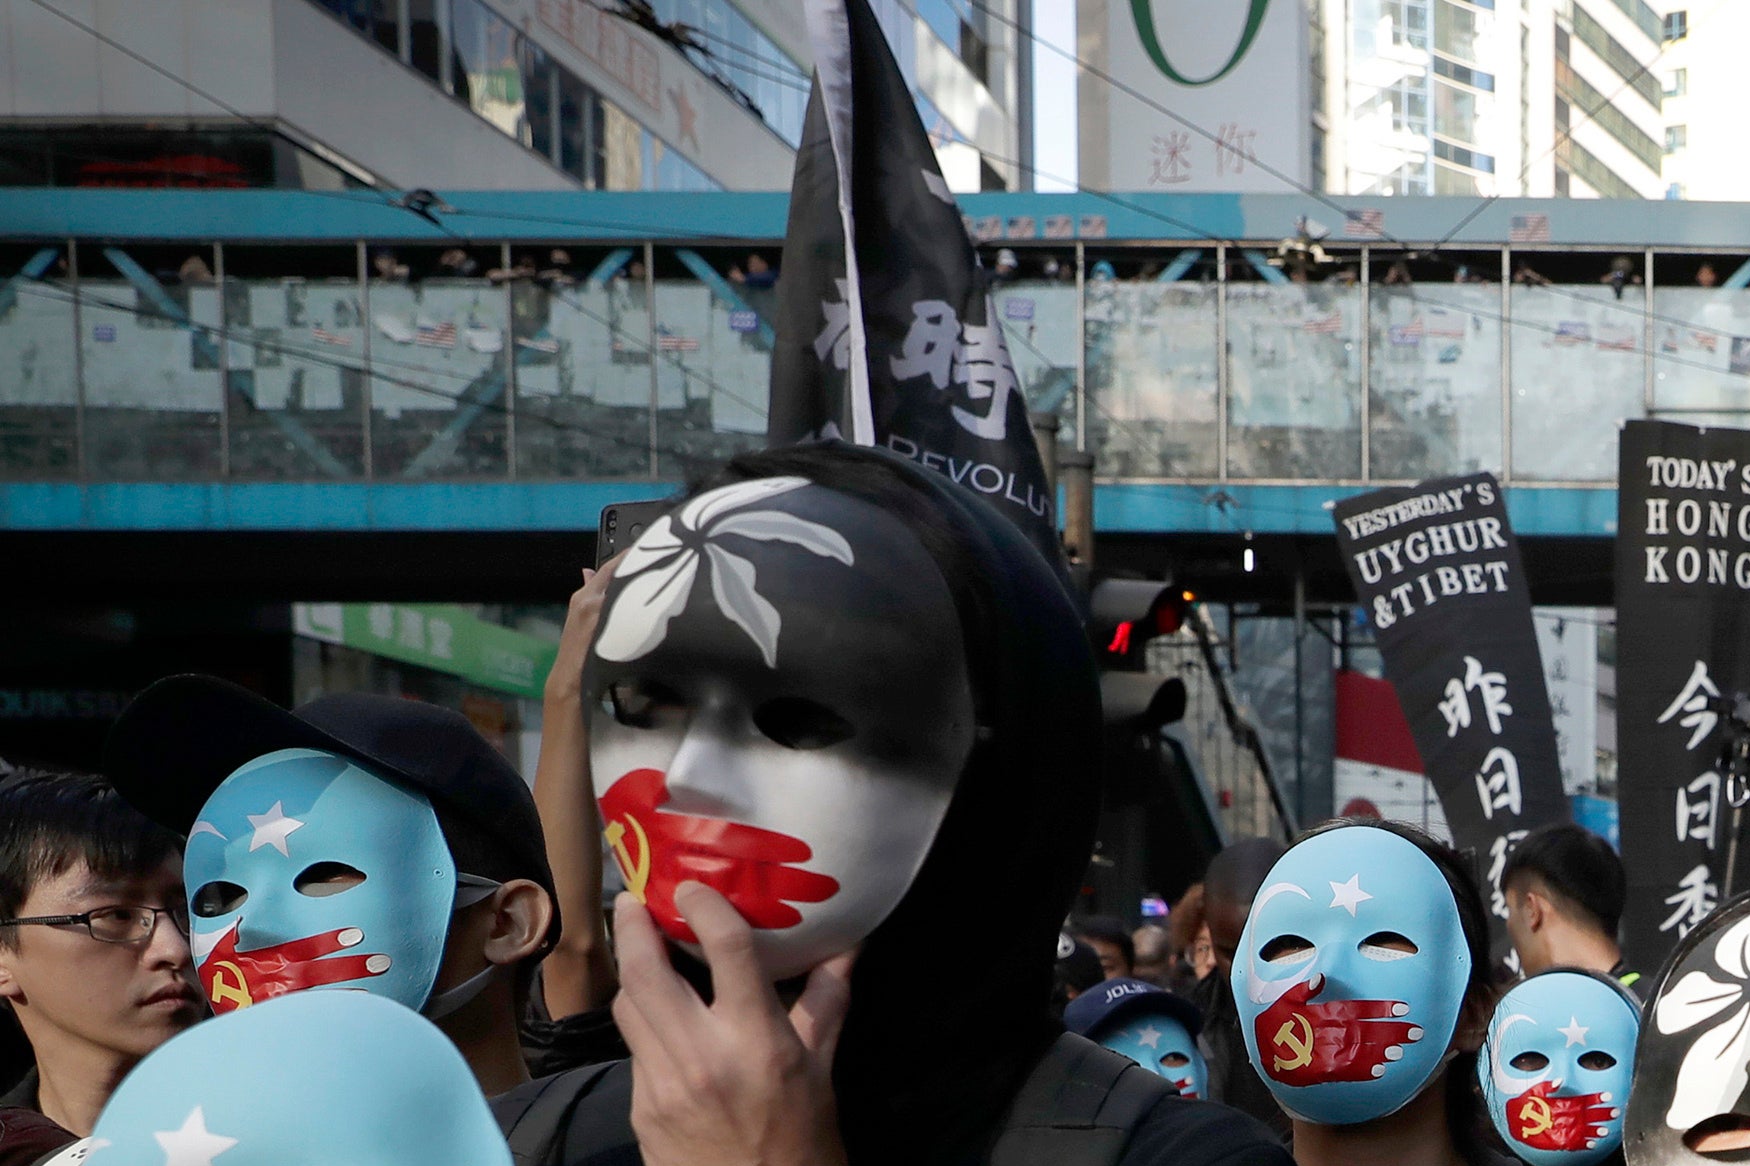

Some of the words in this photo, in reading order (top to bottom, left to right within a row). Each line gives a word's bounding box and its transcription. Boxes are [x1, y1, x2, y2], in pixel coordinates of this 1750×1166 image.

[1340, 483, 1496, 542] YESTERDAY'S
[1355, 513, 1509, 588] UYGHUR
[1371, 559, 1510, 631] &TIBET
